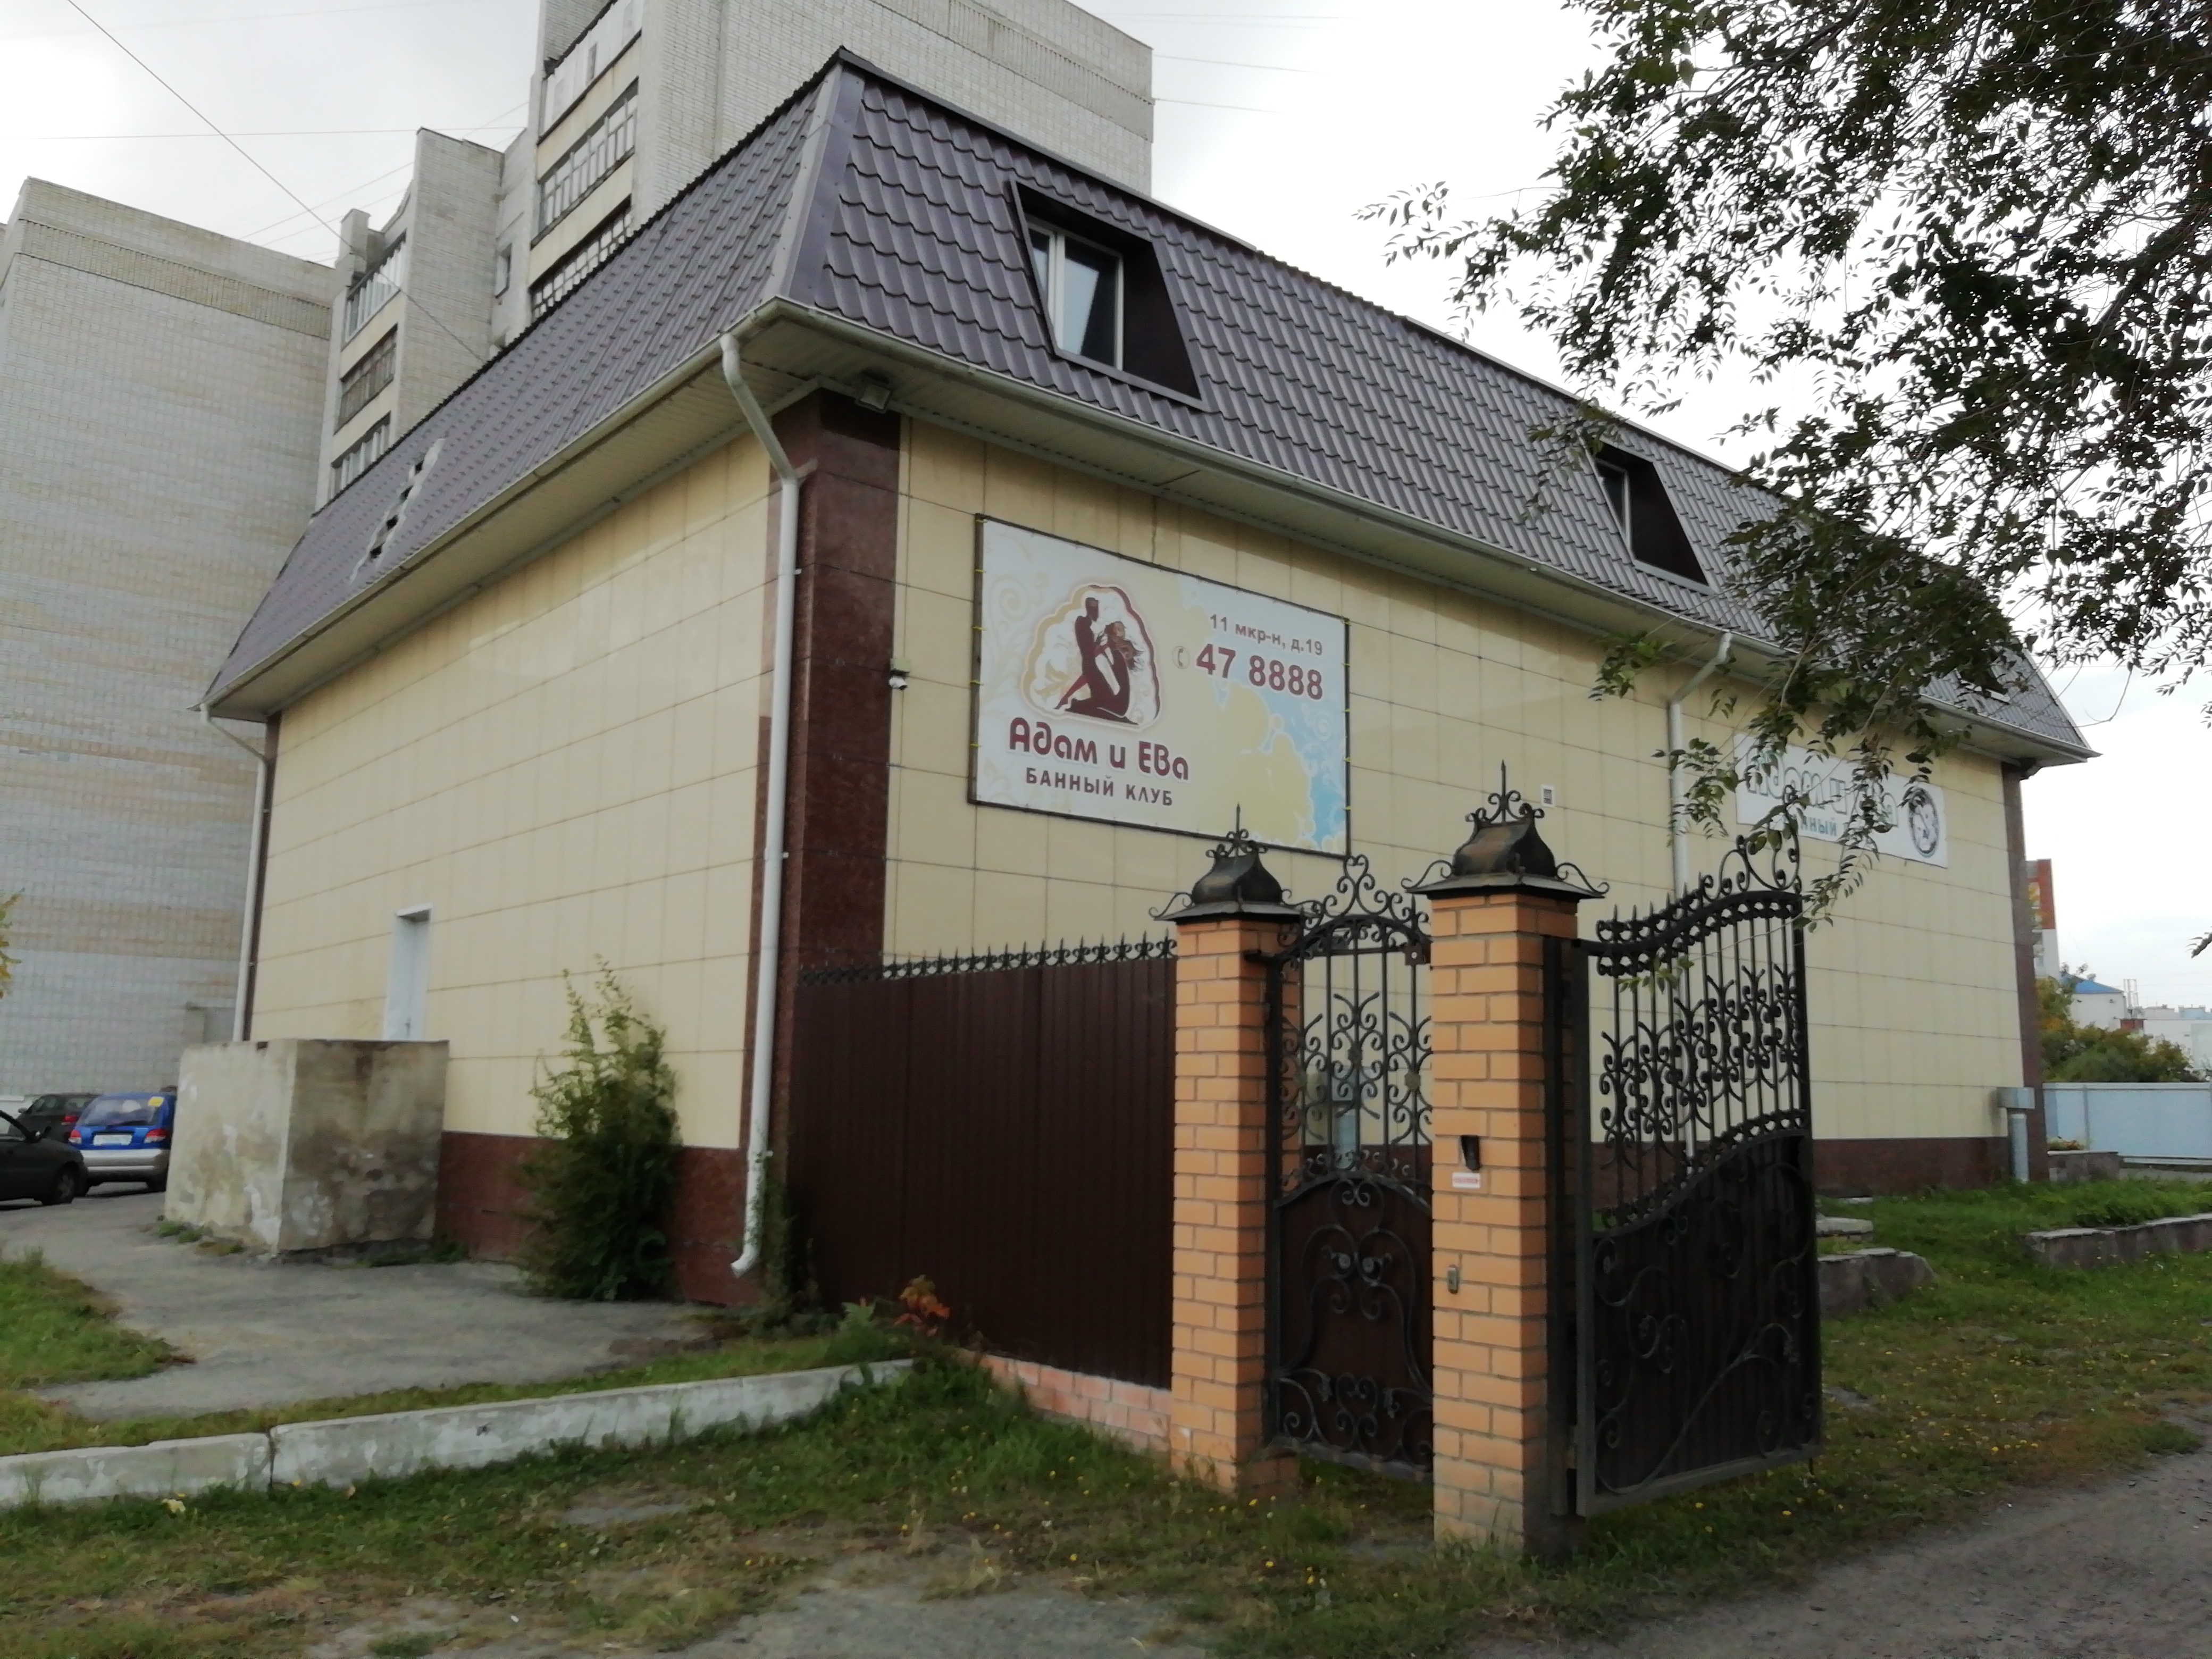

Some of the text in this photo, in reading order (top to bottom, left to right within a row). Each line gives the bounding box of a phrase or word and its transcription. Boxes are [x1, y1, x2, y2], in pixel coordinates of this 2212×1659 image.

[1210, 614, 1227, 632] 11
[1196, 643, 1323, 700] 47 8888
[1010, 717, 1097, 765] Адам
[1110, 744, 1126, 769] и
[1026, 767, 1172, 806] БАННЫЙ КЛУБ
